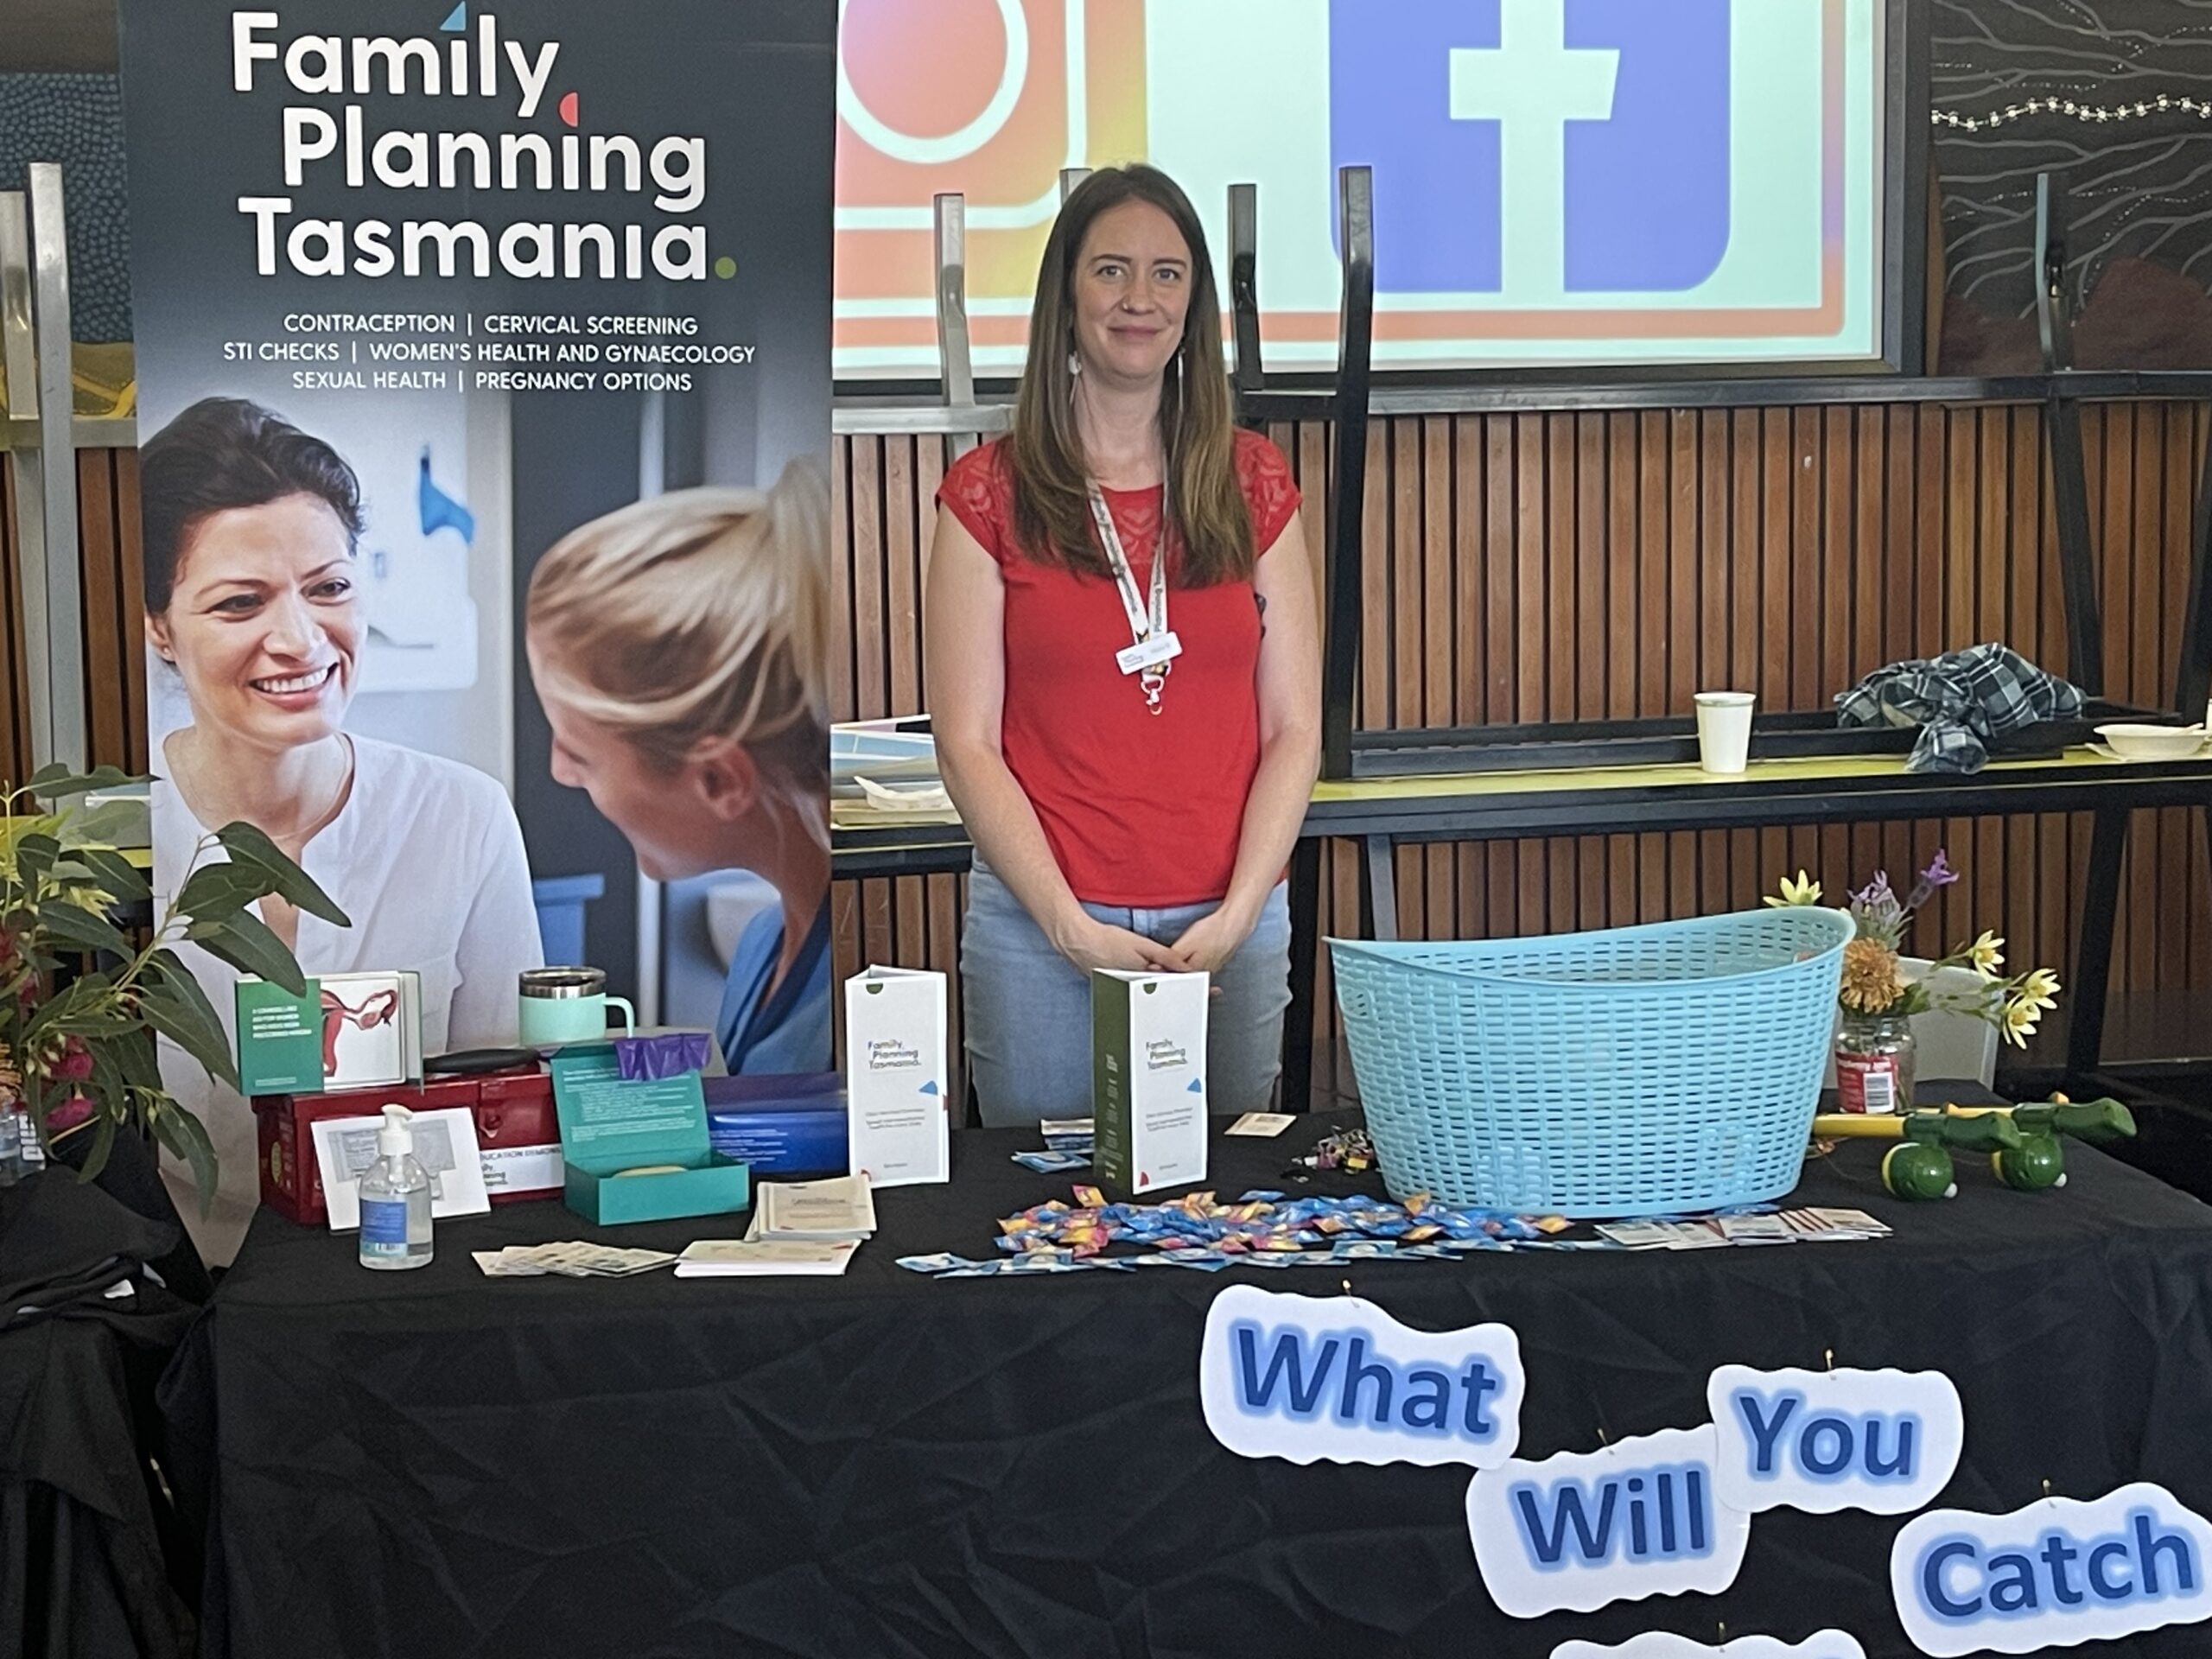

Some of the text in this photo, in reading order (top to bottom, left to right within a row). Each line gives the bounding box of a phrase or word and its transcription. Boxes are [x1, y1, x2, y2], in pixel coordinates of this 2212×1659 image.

[232, 2, 561, 118] Family
[283, 92, 706, 213] Planning
[224, 343, 756, 365] STI CHECKS WOMEN'S HEALTH AND GYNAECOLOGY
[283, 314, 698, 335] CONTRACEPTION CERVICAL SCREENING
[292, 372, 693, 392] SEXUAL HEALTH PREGNANCY OPTIONS
[1237, 1327, 1497, 1435] What
[1739, 1395, 1914, 1478] You
[1516, 1470, 1706, 1563] Will
[1923, 1515, 2194, 1618] Catch
